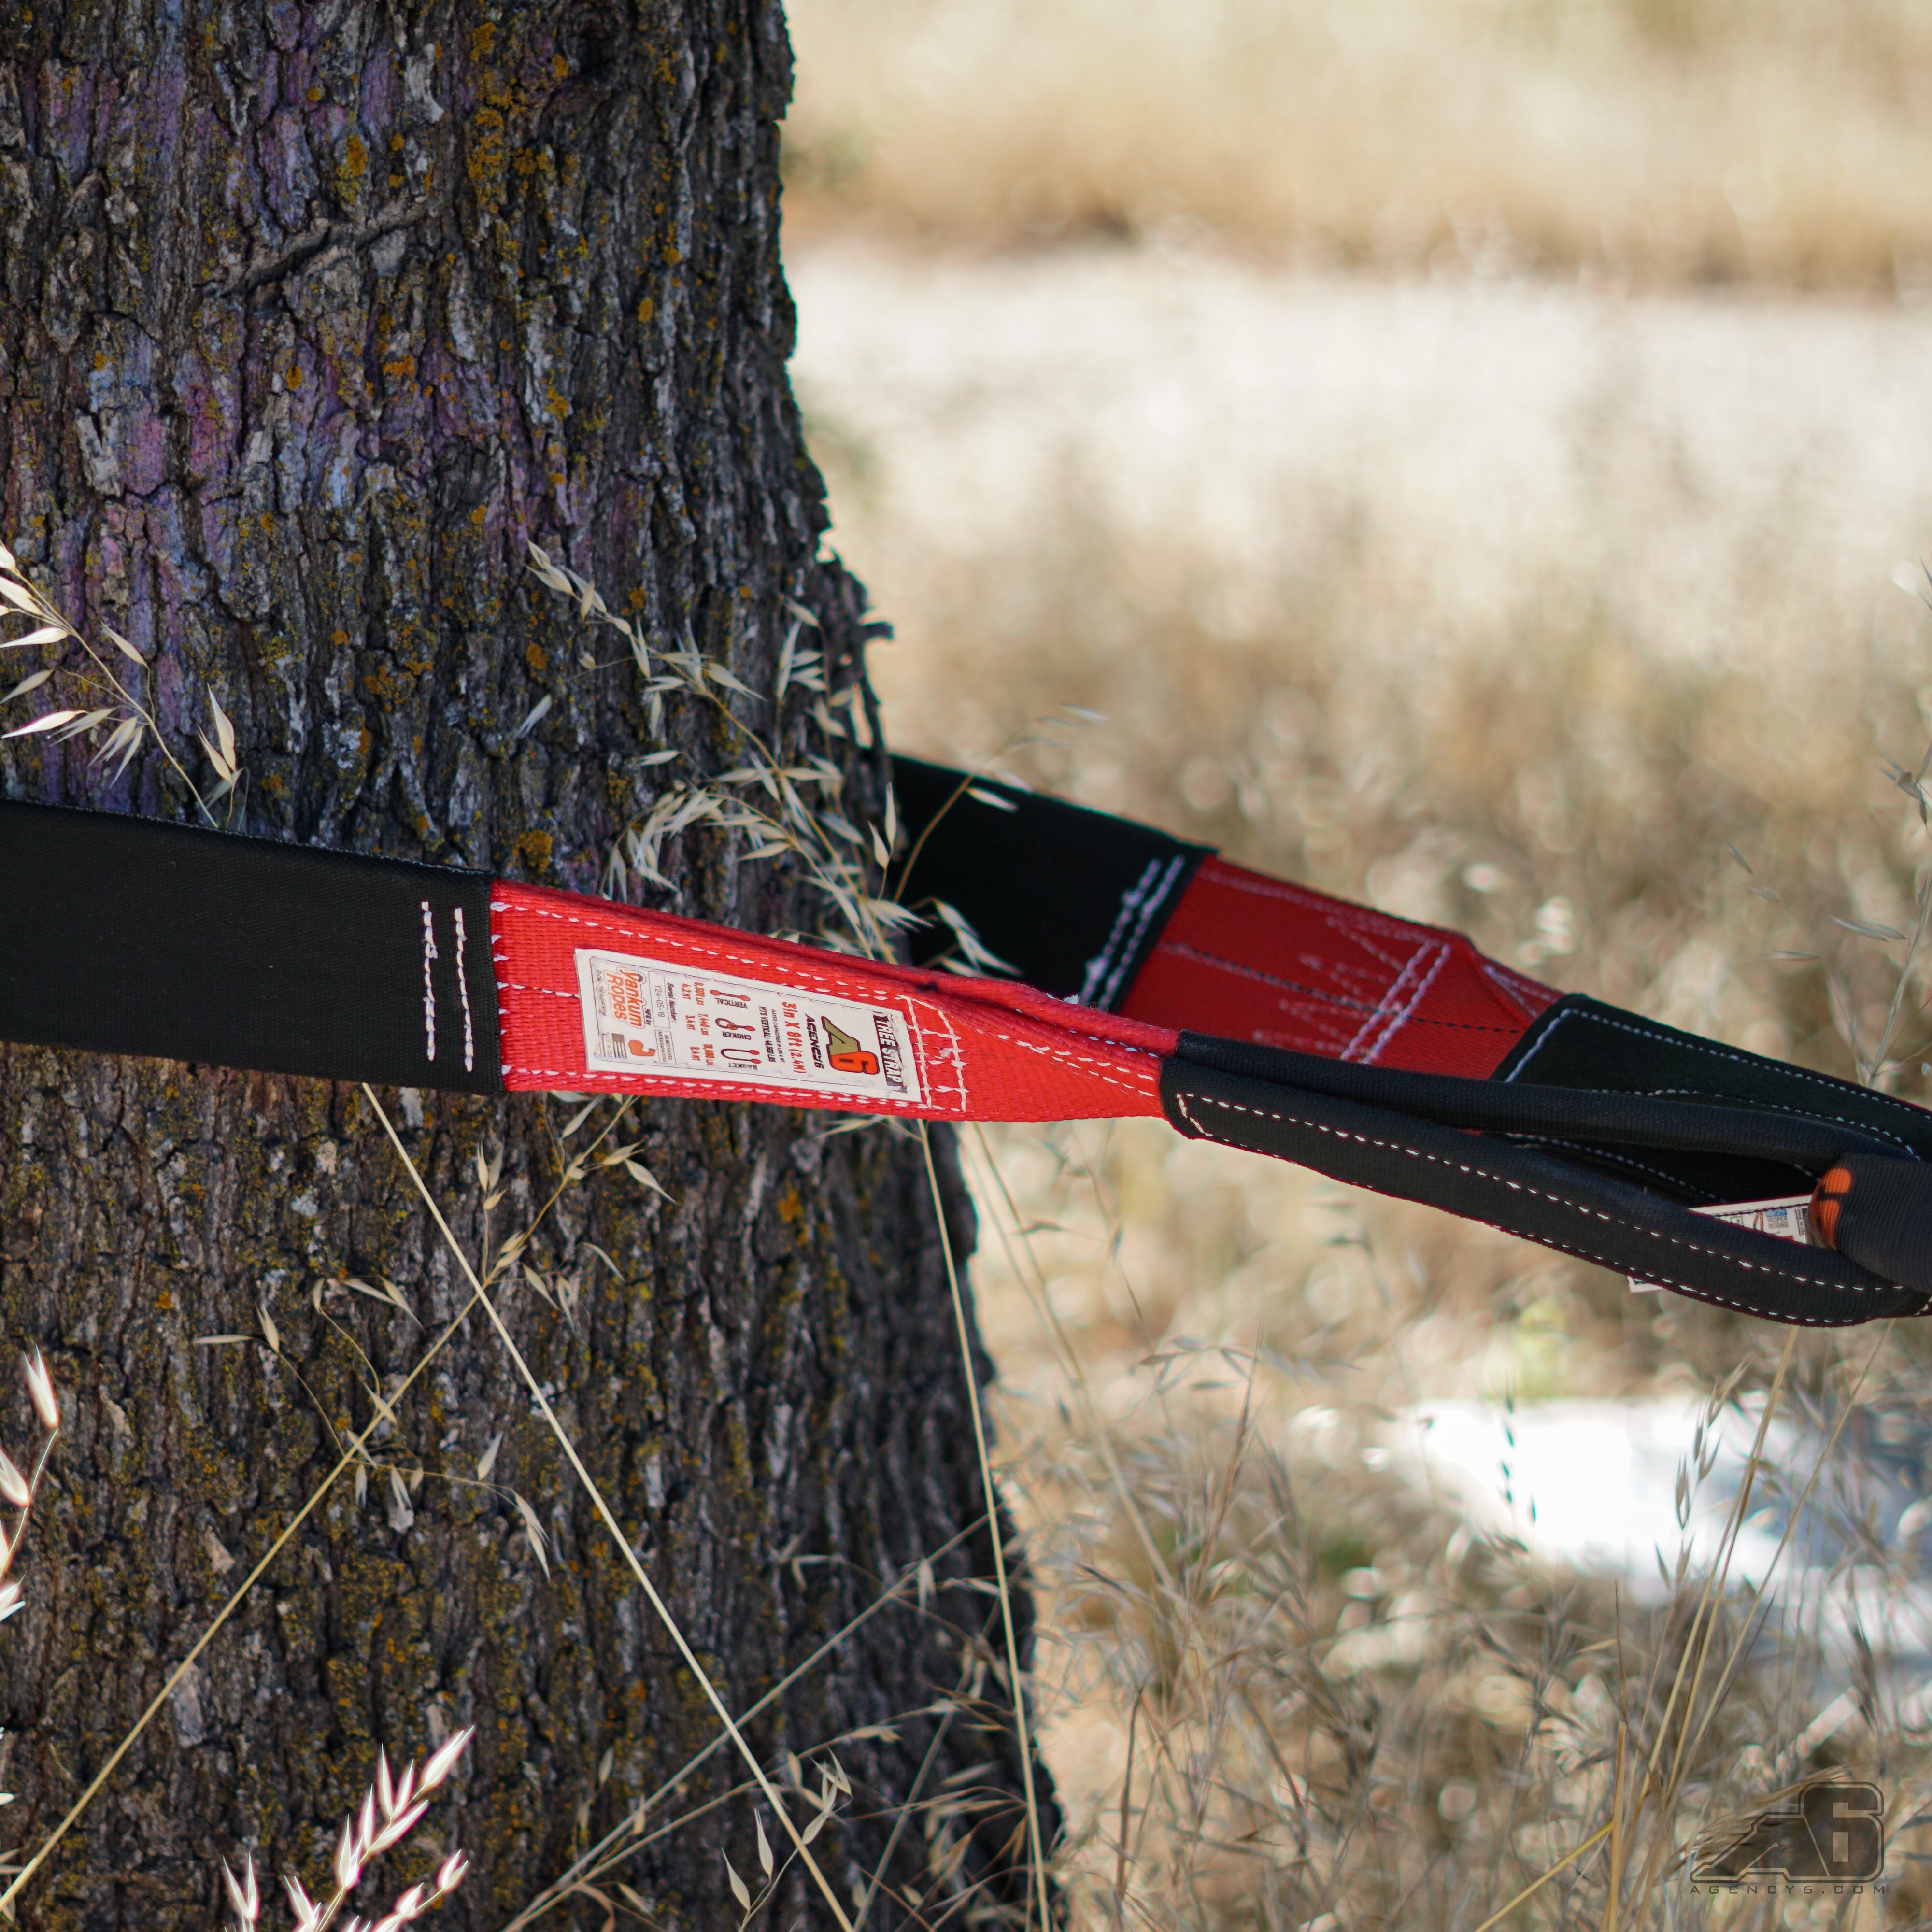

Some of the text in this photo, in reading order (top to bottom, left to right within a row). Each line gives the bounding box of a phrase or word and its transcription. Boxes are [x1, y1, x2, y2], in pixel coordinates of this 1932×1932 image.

[606, 973, 627, 1020] Ropes
[654, 985, 665, 1017] Y24-05-19
[667, 982, 677, 1023] Serial Number:
[681, 983, 692, 993] 4.2
[714, 997, 748, 1009] VERTICAL
[722, 1031, 752, 1040] CHOKER
[760, 1016, 771, 1039] VERTICAL:
[767, 1053, 776, 1062] LBS
[773, 1022, 781, 1043] CAPACITIES
[781, 1001, 806, 1073] 3in X 8ft (2.4M)
[805, 1014, 824, 1068] AGENCY6
[728, 1062, 757, 1070] BASKET
[876, 1019, 902, 1083] TREE STRAP
